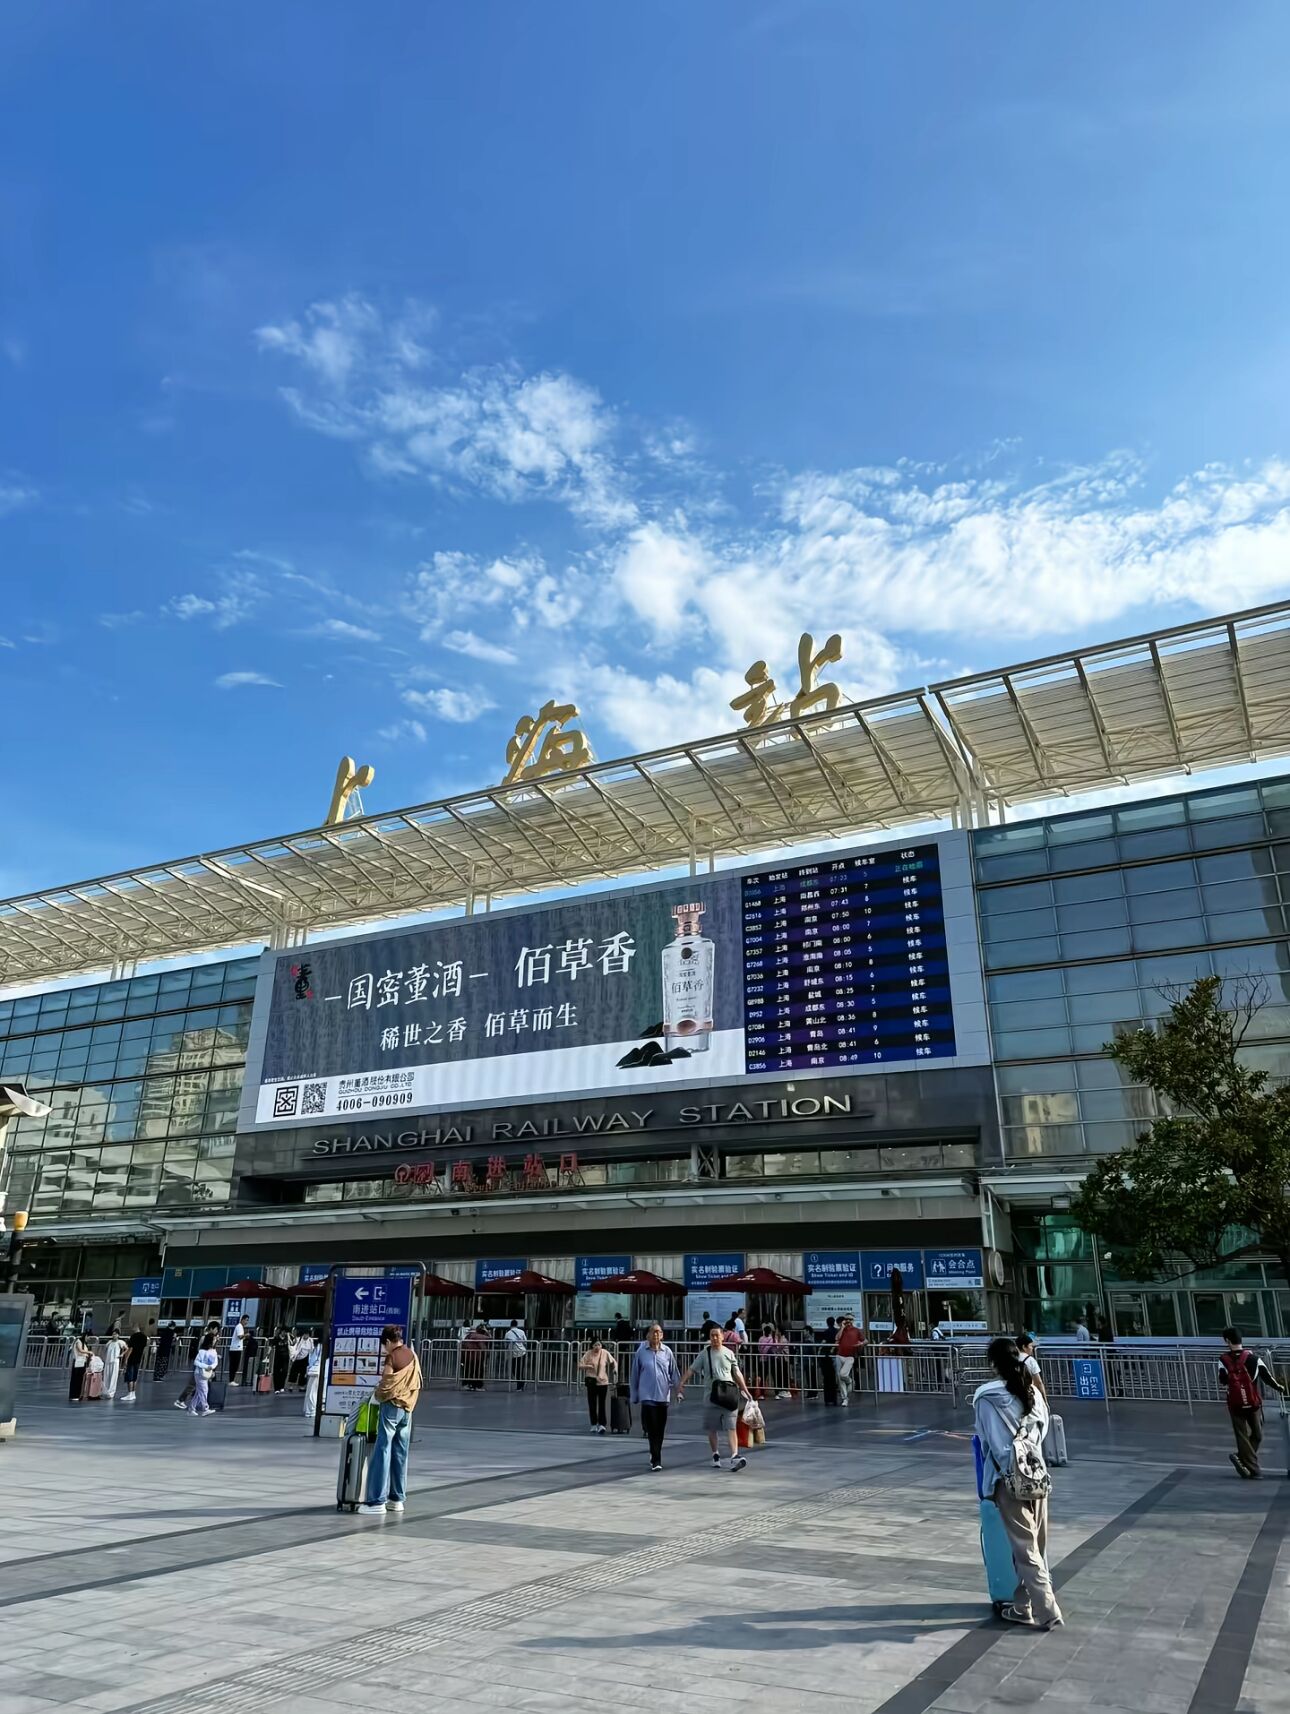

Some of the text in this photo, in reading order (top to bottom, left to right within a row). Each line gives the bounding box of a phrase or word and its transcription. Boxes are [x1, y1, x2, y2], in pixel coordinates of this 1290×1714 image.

[831, 862, 844, 870] 开点
[773, 895, 786, 903] 上海
[830, 886, 847, 894] 07:31
[902, 875, 916, 883] 候车
[773, 907, 786, 915] 上海
[903, 887, 917, 896] 候车
[774, 920, 786, 928] 上海
[804, 915, 817, 923] 南京
[831, 911, 849, 919] 07:50
[904, 900, 918, 908] 候车
[774, 932, 787, 940] 上海
[805, 927, 818, 935] 南京
[905, 913, 919, 921] 候车
[775, 944, 787, 952] 上海
[906, 925, 920, 934] 候车
[515, 931, 637, 988] 佰草香
[775, 956, 788, 964] 上海
[907, 938, 921, 947] 候车
[775, 969, 788, 977] 上海
[806, 965, 820, 973] 南京
[834, 961, 852, 969] 08:10
[908, 951, 923, 960] 候车
[776, 981, 789, 989] 上海
[835, 974, 853, 982] 08:15
[909, 965, 924, 973] 候车
[776, 994, 789, 1002] 上海
[835, 987, 853, 995] 08:25
[910, 978, 925, 986] 候车
[777, 1007, 789, 1015] 上海
[805, 1003, 825, 1012] 成都东
[836, 1000, 854, 1008] 08:30
[911, 991, 926, 1000] 候车
[379, 1003, 578, 1052] 稀世之香 佰草而生
[777, 1020, 790, 1028] 上海
[837, 1013, 855, 1021] 08:36
[912, 1005, 927, 1014] 候车
[777, 1033, 790, 1041] 上海
[809, 1030, 823, 1038] 青岛
[838, 1027, 856, 1035] 08:41
[913, 1019, 928, 1027] 候车
[778, 1046, 791, 1054] 上海
[807, 1043, 827, 1051] 青岛北
[838, 1040, 856, 1048] 08:41
[914, 1033, 929, 1041] 候车
[778, 1059, 791, 1067] 上海
[810, 1056, 824, 1064] 南京
[915, 1047, 930, 1055] 候车
[338, 1071, 415, 1090] 贵州董酒股份有限公司
[336, 1092, 413, 1112] 4006-090909
[312, 1094, 851, 1155] SHANGHAI RAILWAY STATION
[451, 1152, 578, 1183] 南进站口
[948, 1259, 976, 1269] 会合点
[1079, 1375, 1090, 1396] 出口
